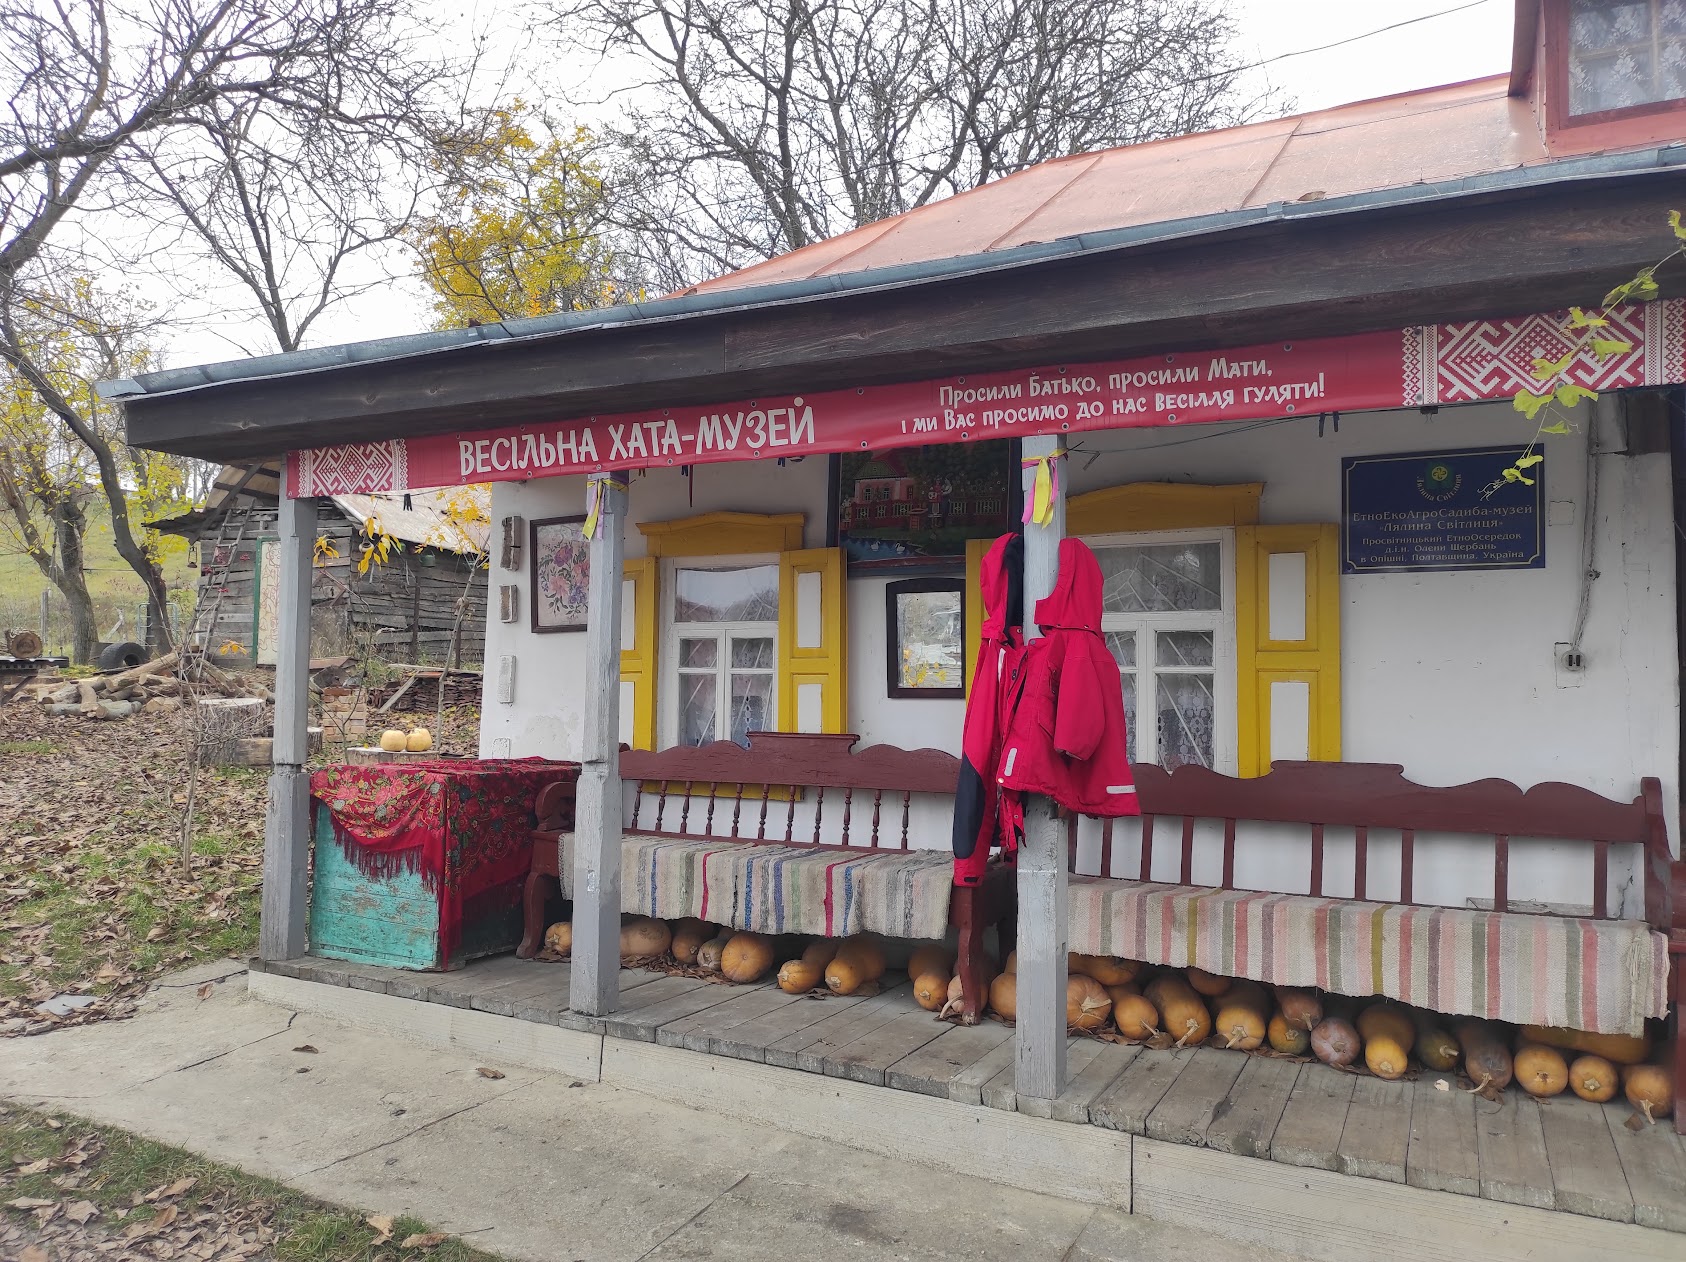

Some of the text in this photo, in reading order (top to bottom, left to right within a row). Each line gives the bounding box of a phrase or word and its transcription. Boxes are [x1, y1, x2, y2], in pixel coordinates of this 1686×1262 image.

[940, 357, 1273, 409] Просили Батько, просили Мати,
[912, 416, 938, 433] ми
[944, 409, 976, 430] Вас
[983, 404, 1069, 429] просимо
[1076, 401, 1105, 420] до
[1112, 397, 1147, 414] нас
[1243, 372, 1325, 404] гуляти!
[459, 397, 815, 476] ВЕСІЛЬНА ХАТА-МУЗЕЙ
[1353, 505, 1533, 522] ЕтноЕкоАгроСадиба-музей
[1362, 533, 1522, 546] Просвітницький ЕтноОсередок
[1414, 545, 1446, 553] Олени
[1483, 550, 1524, 560] Україна
